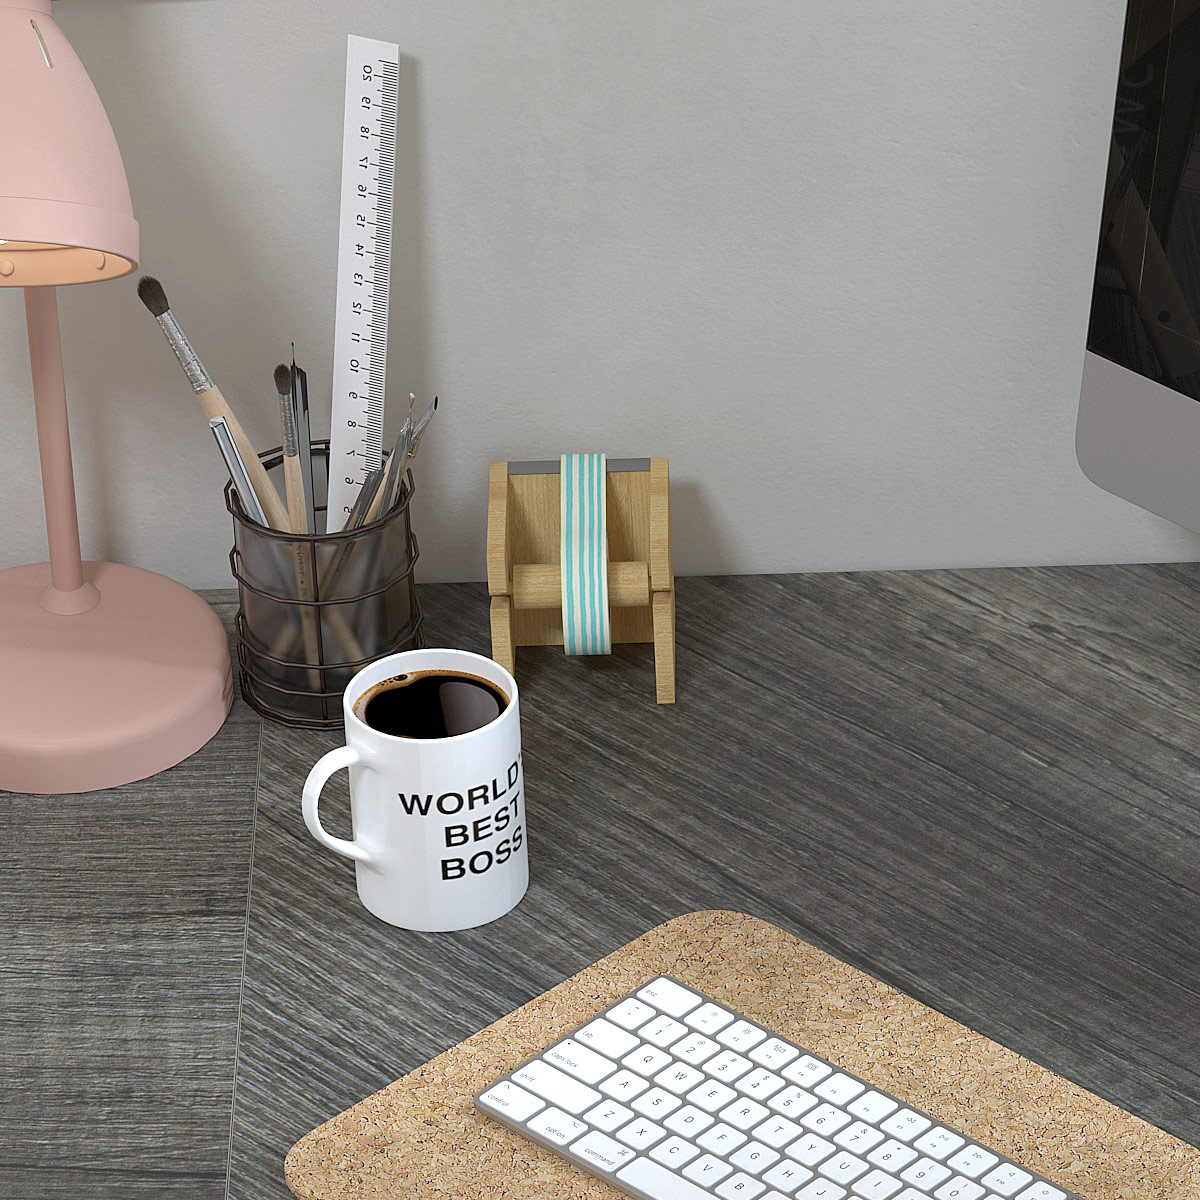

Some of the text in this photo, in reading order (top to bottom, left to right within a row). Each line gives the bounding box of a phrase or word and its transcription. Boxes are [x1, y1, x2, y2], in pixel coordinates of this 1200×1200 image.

[444, 791, 520, 848] BEST
[440, 825, 523, 881] BOSS
[685, 1046, 696, 1054] 2
[643, 1055, 654, 1064] Q
[519, 1072, 535, 1083] shift
[674, 1071, 688, 1081] W
[619, 1081, 629, 1089] A
[707, 1090, 719, 1098] E
[487, 1094, 511, 1107] control
[652, 1098, 663, 1106] S
[782, 1099, 794, 1107] 5
[603, 1110, 616, 1119] Z
[739, 1107, 751, 1116] R
[683, 1115, 695, 1124] D
[815, 1117, 826, 1125] 6
[545, 1126, 566, 1139] option
[636, 1128, 648, 1137] X
[774, 1125, 784, 1133] T
[849, 1134, 860, 1142] 7
[669, 1146, 680, 1154] C
[807, 1143, 817, 1151] Y
[584, 1148, 616, 1166] command
[749, 1152, 761, 1160] G
[881, 1153, 893, 1161] 8
[703, 1164, 714, 1172] V
[839, 1161, 851, 1170] U
[781, 1169, 794, 1178] H
[915, 1171, 926, 1179] 9
[734, 1182, 745, 1191] B
